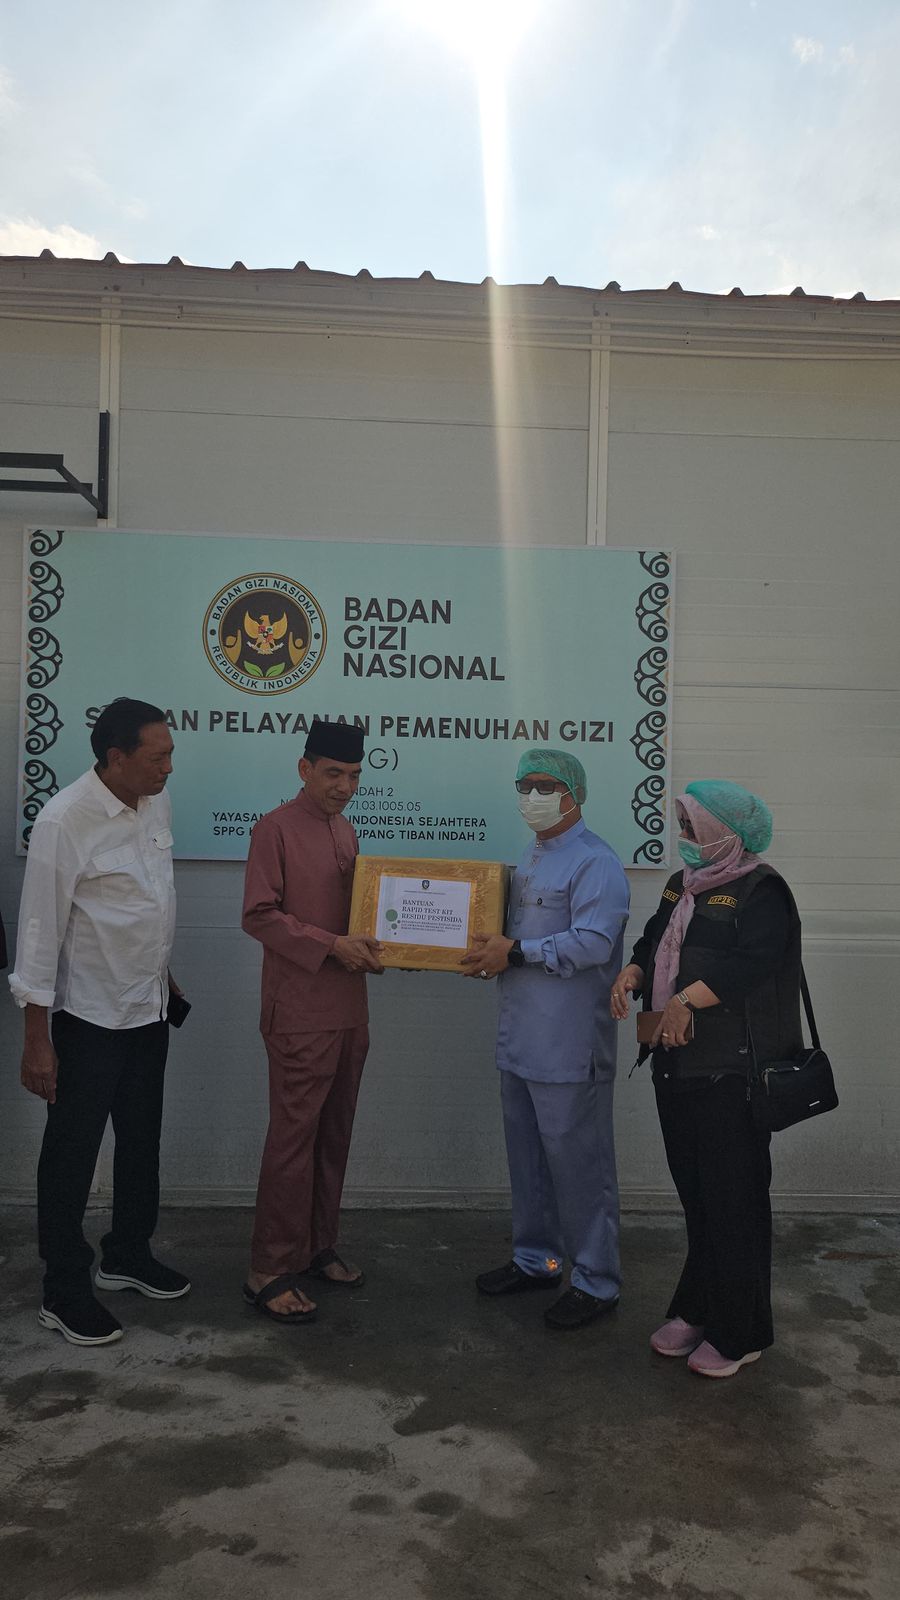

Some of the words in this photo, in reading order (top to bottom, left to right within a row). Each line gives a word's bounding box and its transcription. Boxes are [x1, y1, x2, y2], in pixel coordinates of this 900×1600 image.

[212, 586, 242, 620] BADAN
[245, 579, 268, 590] GIZI
[273, 580, 318, 624] NASIONAL
[344, 597, 452, 624] BADAN
[343, 624, 407, 650] GIZI
[212, 646, 258, 689] REPUBLIK
[263, 650, 318, 690] INDONESIA
[343, 652, 505, 681] NASIONAL
[380, 716, 549, 741] PEMENUHAN
[559, 720, 614, 743] GIZI
[387, 787, 394, 797] 2
[213, 826, 245, 836] SPPG
[399, 830, 434, 840] TIBAN
[438, 831, 475, 841] INDAH
[478, 832, 485, 841] 2
[348, 815, 414, 826] INDONESIA
[418, 817, 487, 827] SEJAHTERA
